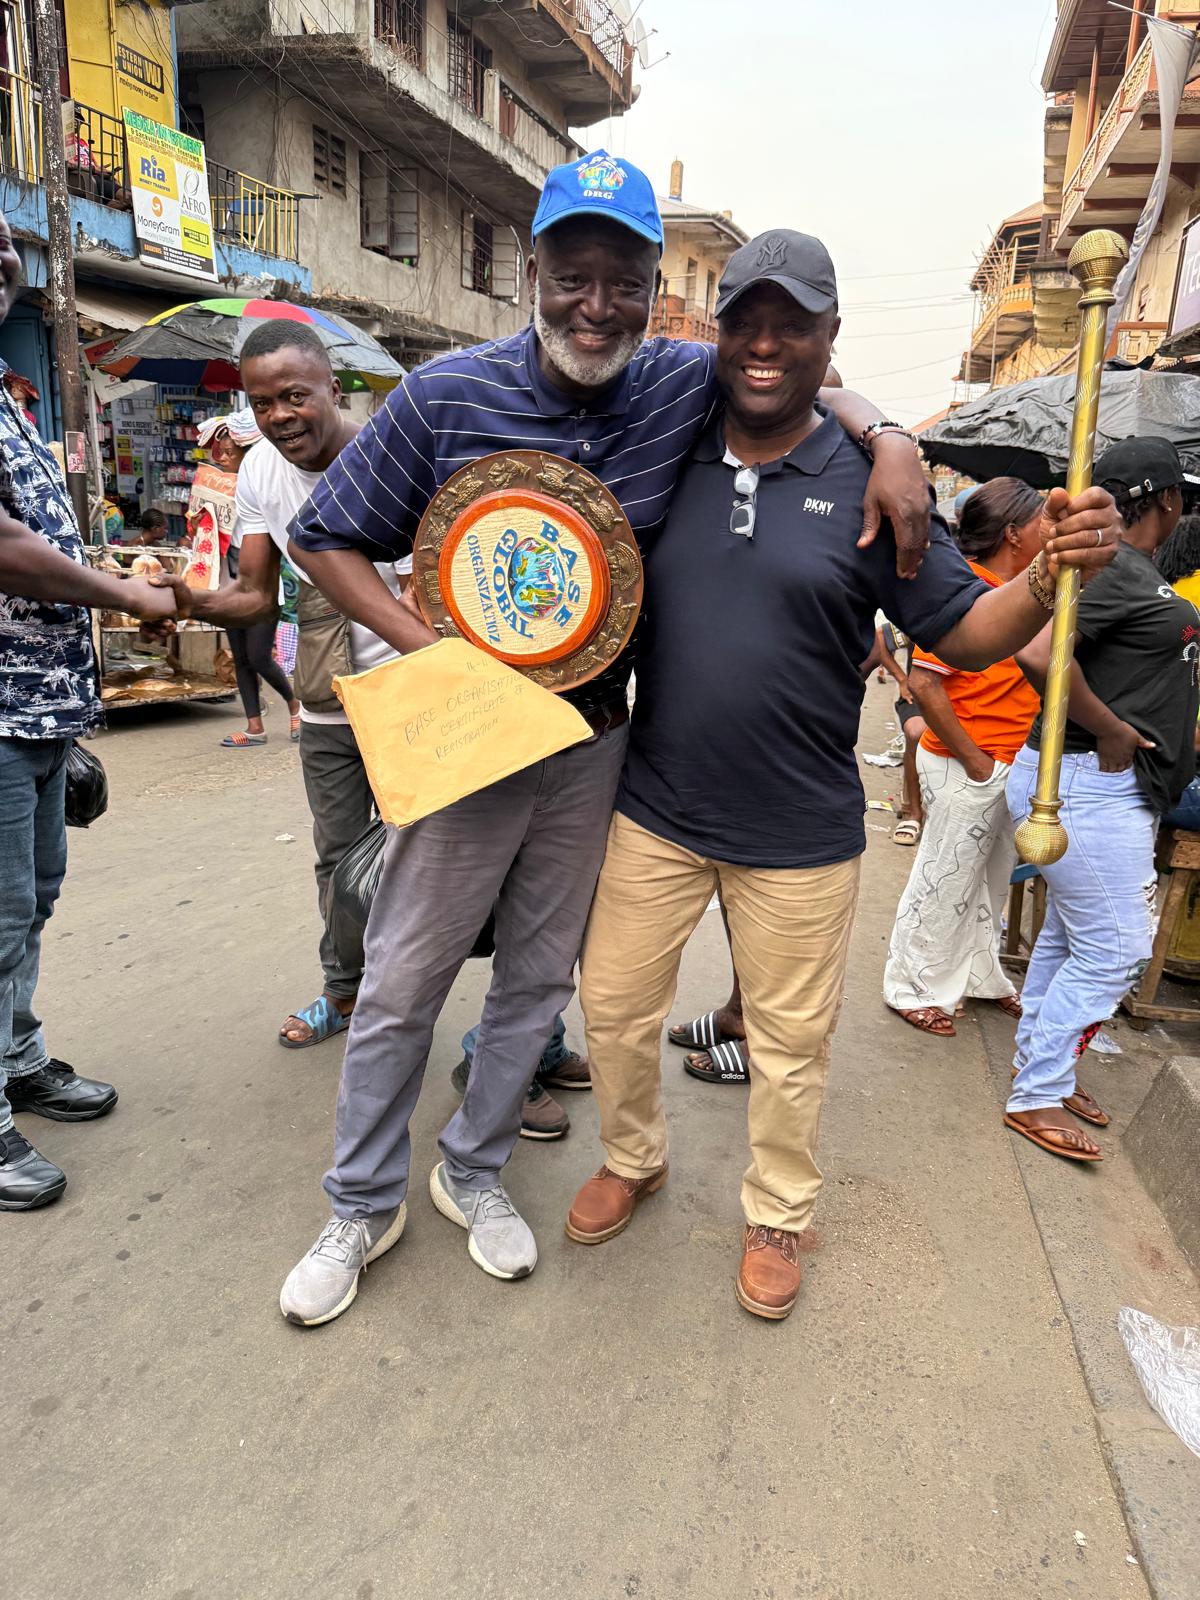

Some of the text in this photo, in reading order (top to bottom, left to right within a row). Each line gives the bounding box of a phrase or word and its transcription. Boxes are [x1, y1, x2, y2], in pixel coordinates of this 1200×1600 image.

[117, 46, 142, 68] ESTERN
[122, 59, 143, 79] UNION
[141, 155, 165, 183] Ria
[576, 155, 628, 178] BASE
[181, 194, 206, 215] AFRO
[137, 213, 180, 236] MoneyGram
[803, 497, 835, 513] DKNY
[493, 528, 534, 639] GLOBAL
[540, 520, 581, 628] BASE
[404, 707, 438, 746] BASE
